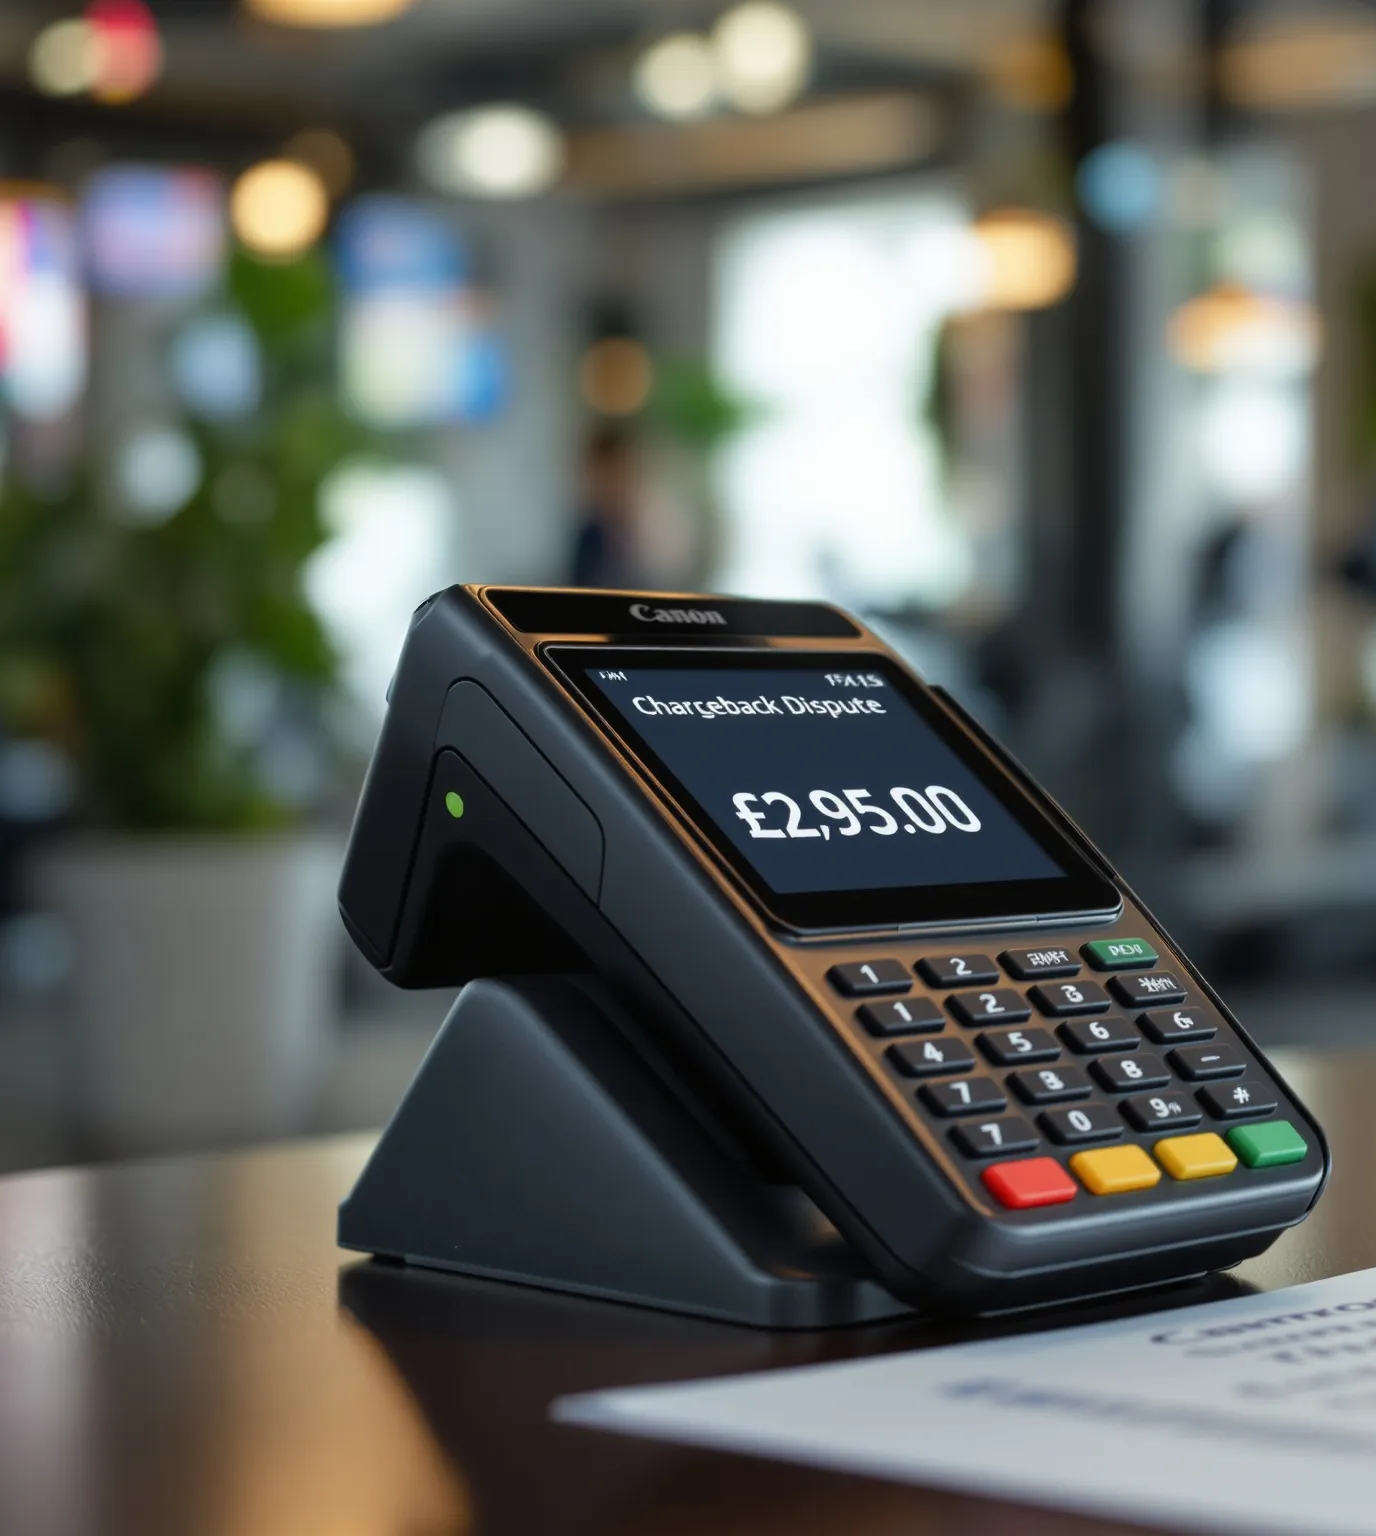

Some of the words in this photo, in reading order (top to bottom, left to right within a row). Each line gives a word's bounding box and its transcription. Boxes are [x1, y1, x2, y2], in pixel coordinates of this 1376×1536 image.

[628, 603, 728, 625] Canon
[780, 695, 887, 719] Dispute
[732, 785, 982, 841] £2,95.00
[860, 964, 879, 984] 1
[949, 957, 973, 977] 2
[893, 1001, 913, 1022] 1
[979, 993, 1006, 1014] 2
[923, 1042, 944, 1063] 4
[1007, 1031, 1033, 1053] 5
[1089, 1021, 1110, 1040] 6
[950, 1081, 971, 1104] 7
[1120, 1059, 1143, 1079] 8
[980, 1123, 1002, 1146] 7
[1067, 1110, 1092, 1132] 0
